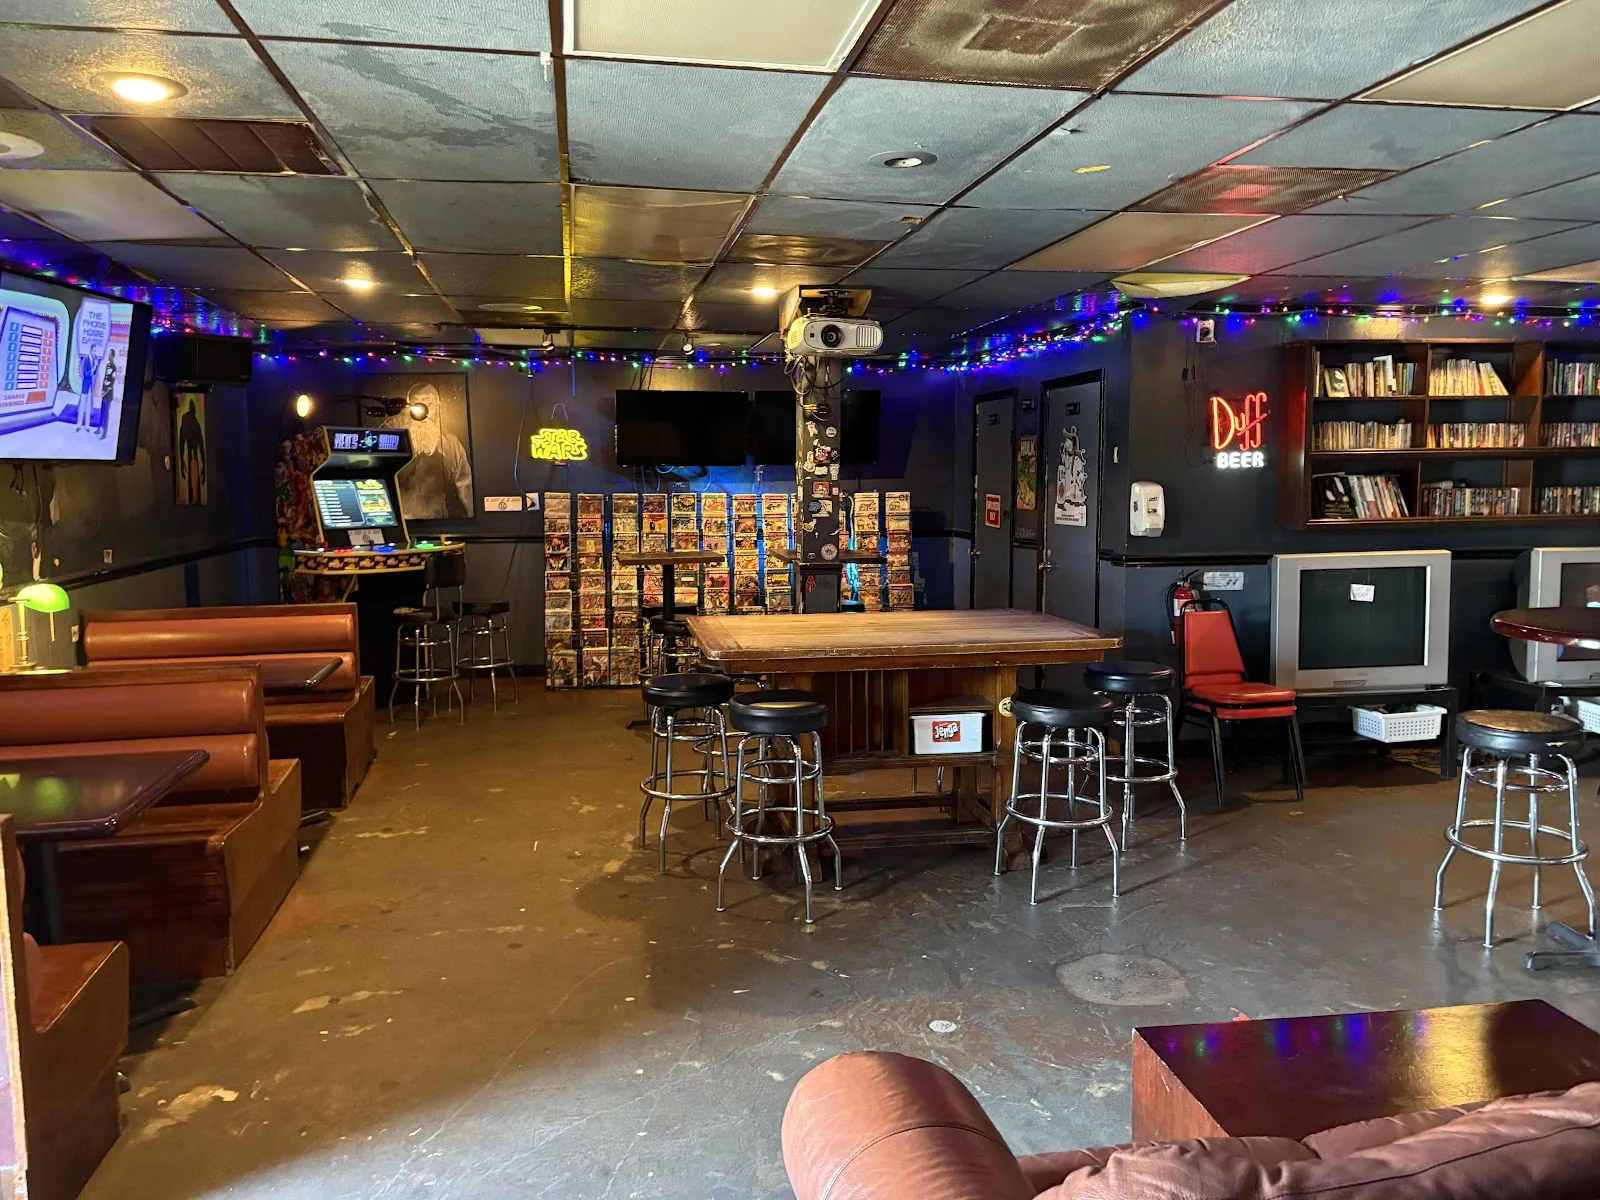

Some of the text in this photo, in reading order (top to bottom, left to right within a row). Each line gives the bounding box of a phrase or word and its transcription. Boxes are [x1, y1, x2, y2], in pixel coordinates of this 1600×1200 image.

[88, 311, 104, 320] THE
[82, 319, 107, 330] PHONE
[83, 328, 105, 338] HOME
[1209, 391, 1268, 451] Duff
[531, 428, 585, 443] STAR
[531, 442, 588, 461] WARS
[1020, 440, 1036, 457] HULK
[1217, 451, 1265, 469] BEER
[934, 722, 959, 739] Jenga
